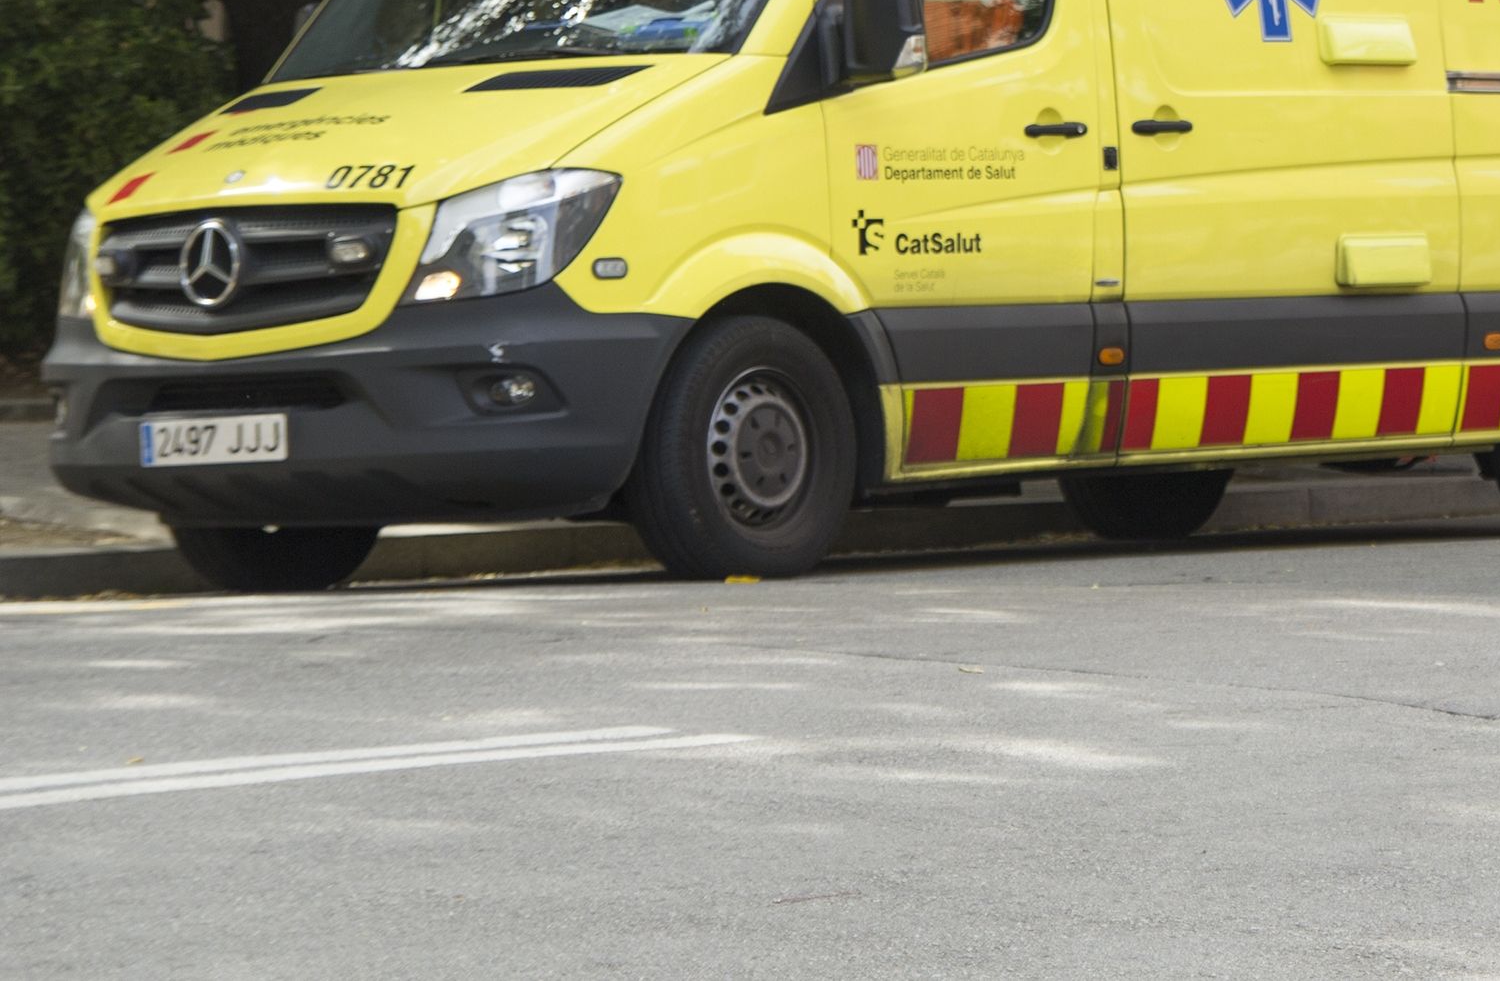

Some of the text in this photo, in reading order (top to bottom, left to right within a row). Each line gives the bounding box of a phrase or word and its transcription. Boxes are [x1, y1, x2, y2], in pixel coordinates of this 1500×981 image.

[883, 146, 1025, 163] Generalitat de Catalunya
[325, 164, 416, 190] 0781
[884, 165, 1016, 183] Departament de Salut
[895, 232, 982, 255] CatSalut
[156, 422, 279, 457] 2497 JJJ
